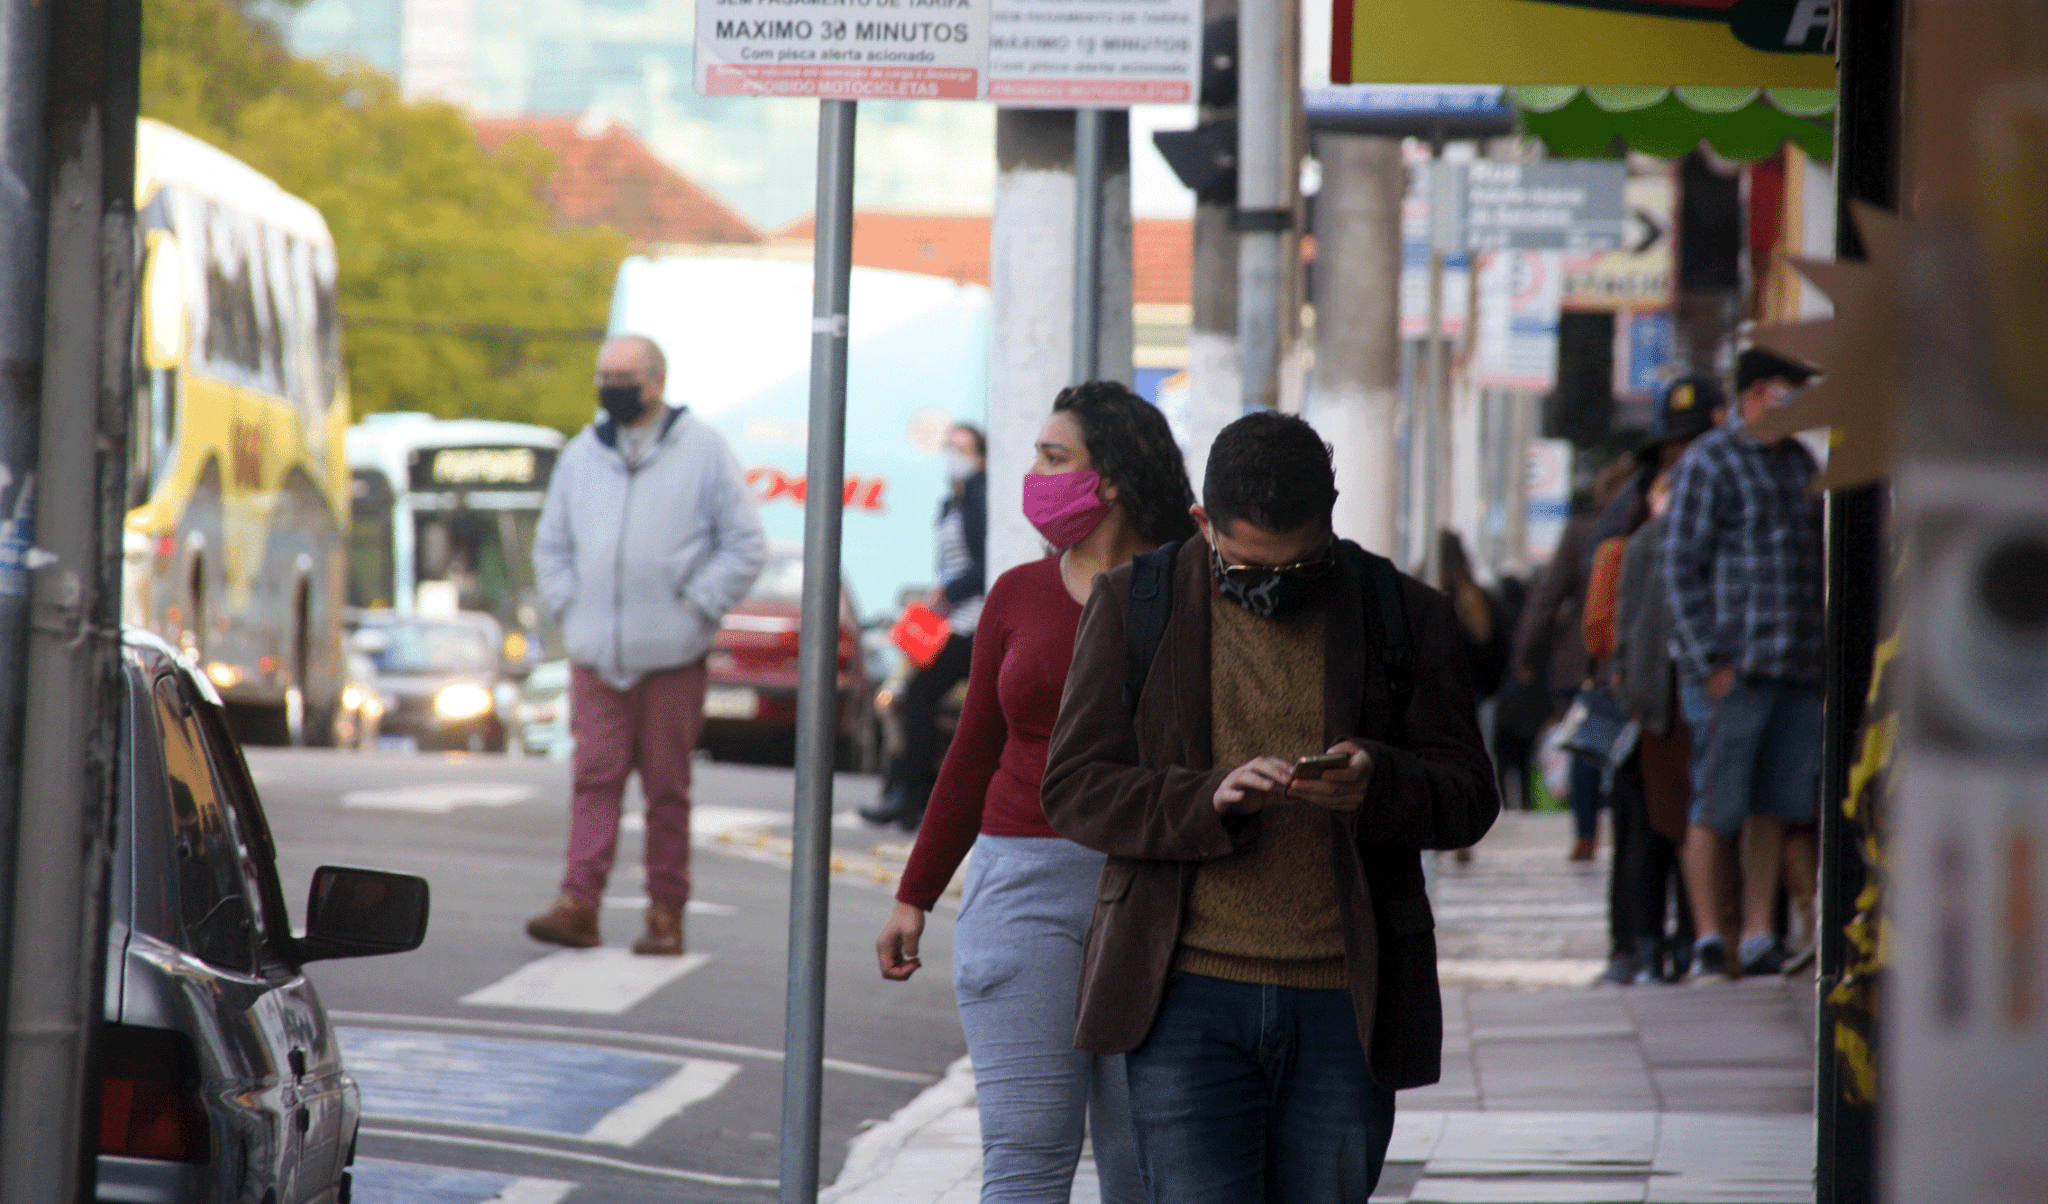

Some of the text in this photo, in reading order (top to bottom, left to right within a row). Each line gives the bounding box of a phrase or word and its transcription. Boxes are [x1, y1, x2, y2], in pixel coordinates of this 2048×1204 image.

[716, 20, 812, 40] MAXIMO
[856, 21, 969, 43] MINUTOS
[741, 46, 935, 62] Com pisca alerta acionado
[818, 81, 939, 96] MOTOCICLETAS
